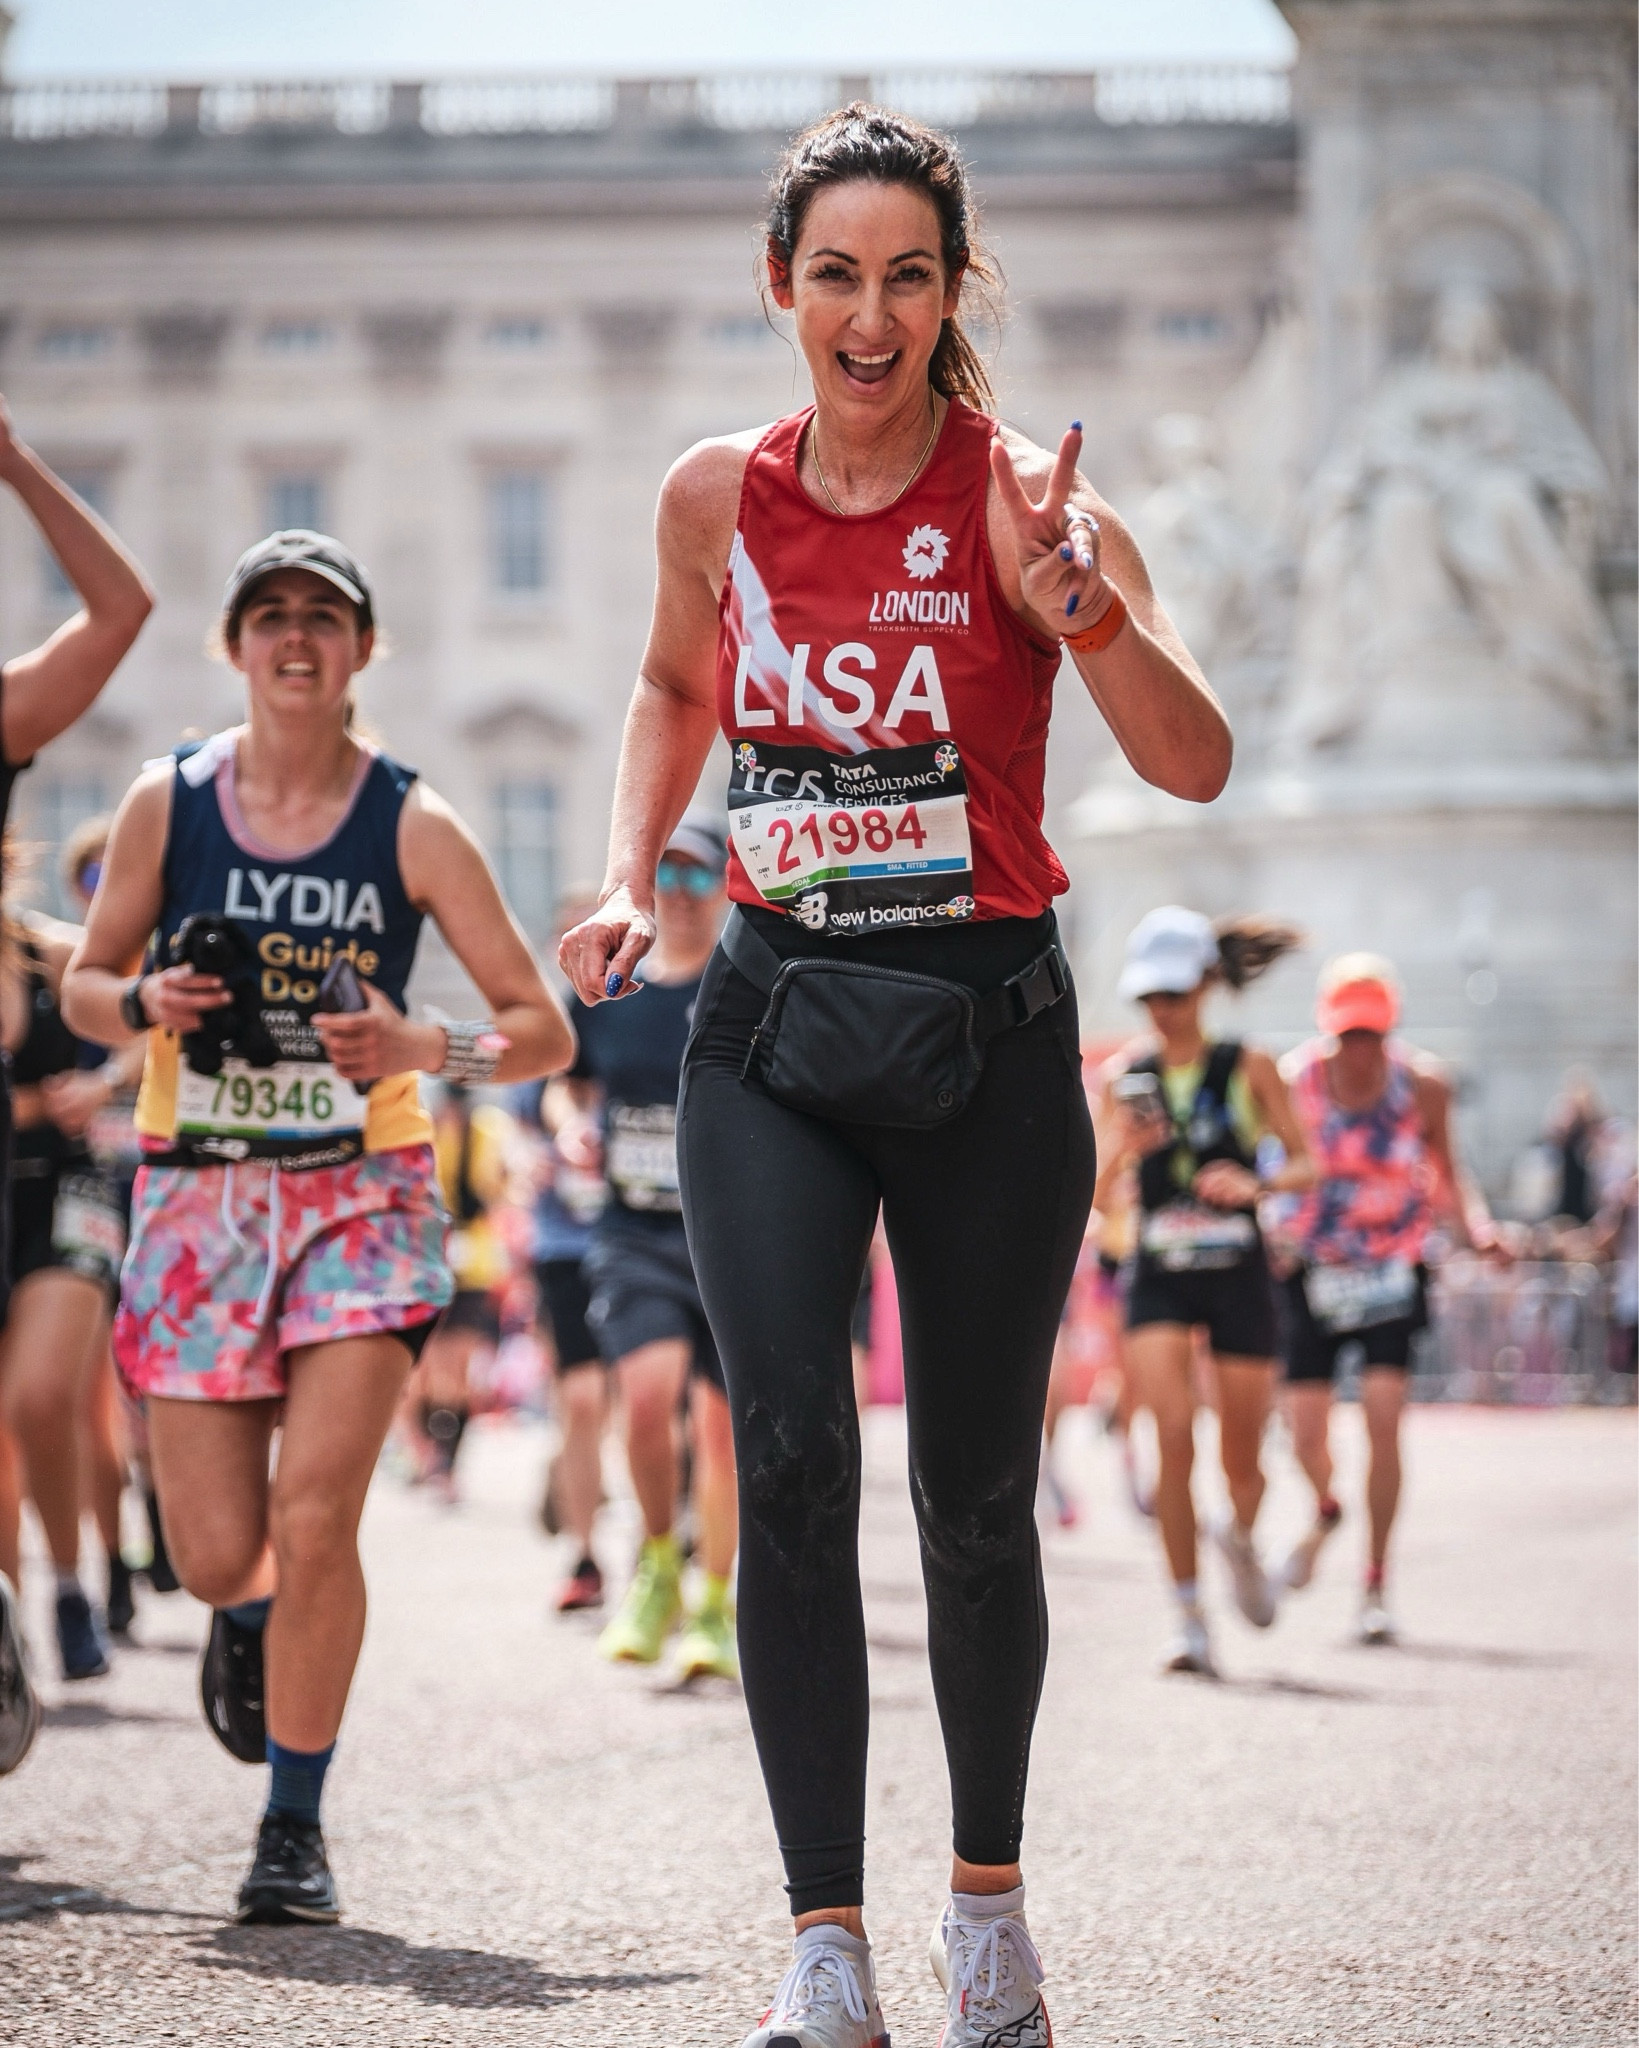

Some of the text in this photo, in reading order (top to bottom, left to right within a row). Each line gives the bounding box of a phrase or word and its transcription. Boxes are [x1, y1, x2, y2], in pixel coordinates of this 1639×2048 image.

[869, 590, 970, 626] LONDON
[868, 625, 920, 633] TRACKSMITH
[922, 626, 955, 634] SUPPLY
[734, 642, 951, 732] LISA
[743, 765, 826, 803] TCS
[829, 762, 878, 781] TATA
[834, 769, 947, 797] CONSULTANCY
[834, 793, 909, 808] SERVICES
[768, 803, 928, 875] 21984
[886, 861, 929, 871] SMA, FITTED
[224, 867, 385, 935] LYDIA
[830, 903, 948, 927] new balance
[207, 1072, 333, 1120] 79346
